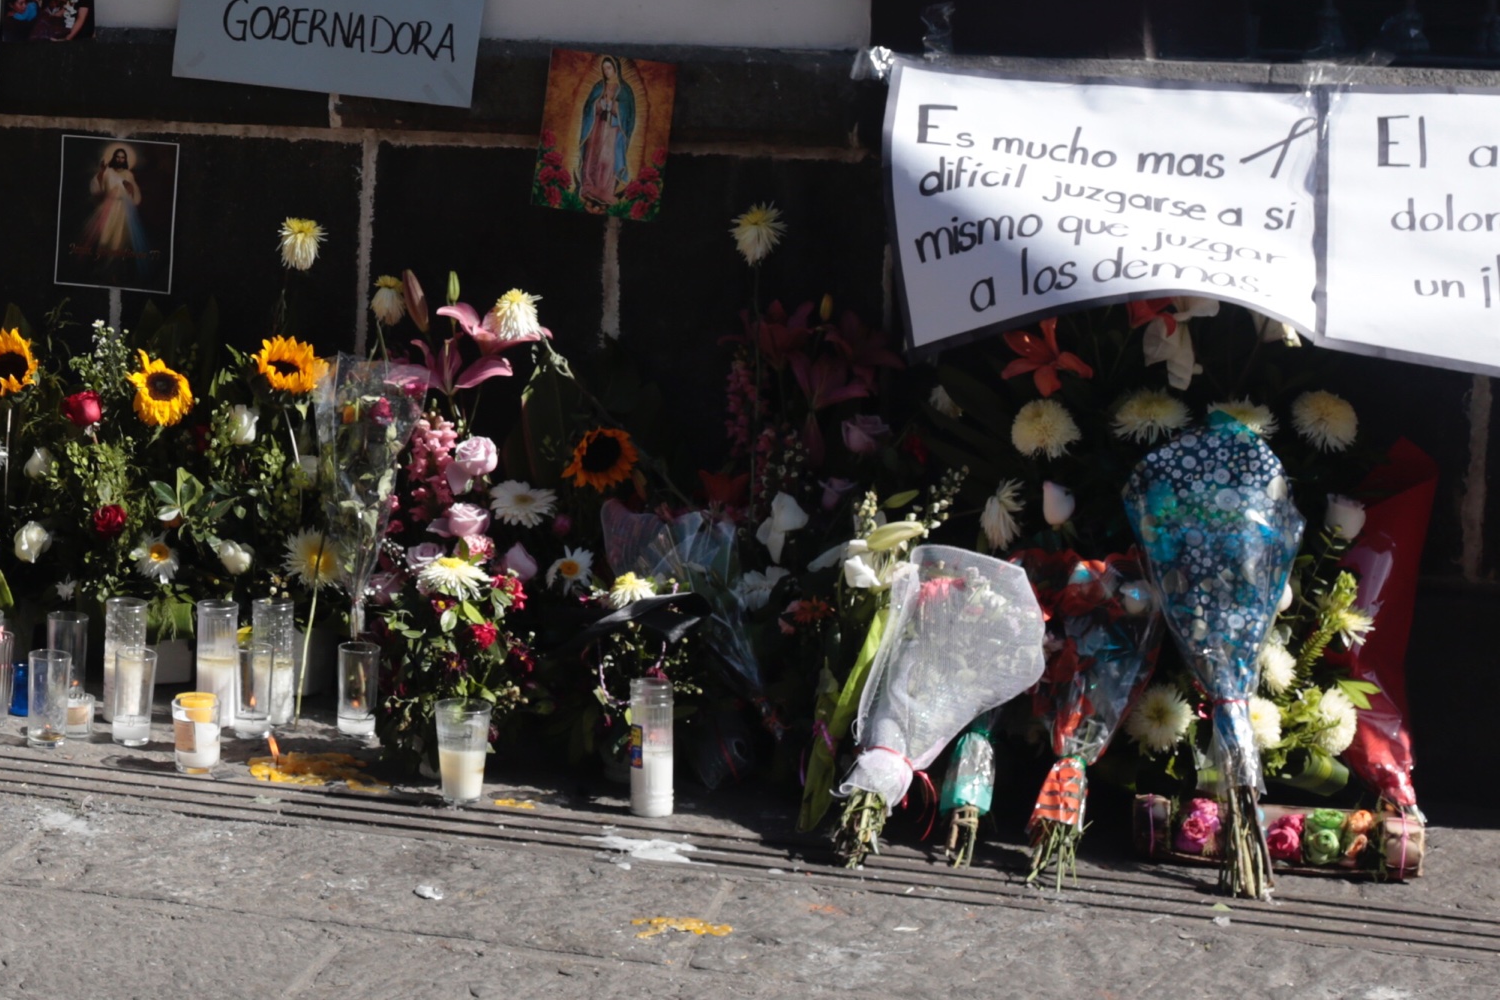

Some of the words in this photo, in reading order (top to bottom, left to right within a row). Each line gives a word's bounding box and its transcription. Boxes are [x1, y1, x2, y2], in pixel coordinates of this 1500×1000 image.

[916, 103, 975, 148] Es
[992, 127, 1118, 169] mucho
[1136, 147, 1226, 179] mas
[1377, 114, 1427, 168] El
[1042, 176, 1207, 222] juzgarse
[1217, 205, 1243, 228] a
[914, 212, 1043, 263] mismo
[1057, 213, 1130, 246] que
[1140, 228, 1287, 264] juzgar
[969, 274, 998, 313] a
[1020, 247, 1079, 296] los
[1414, 279, 1466, 298] un
